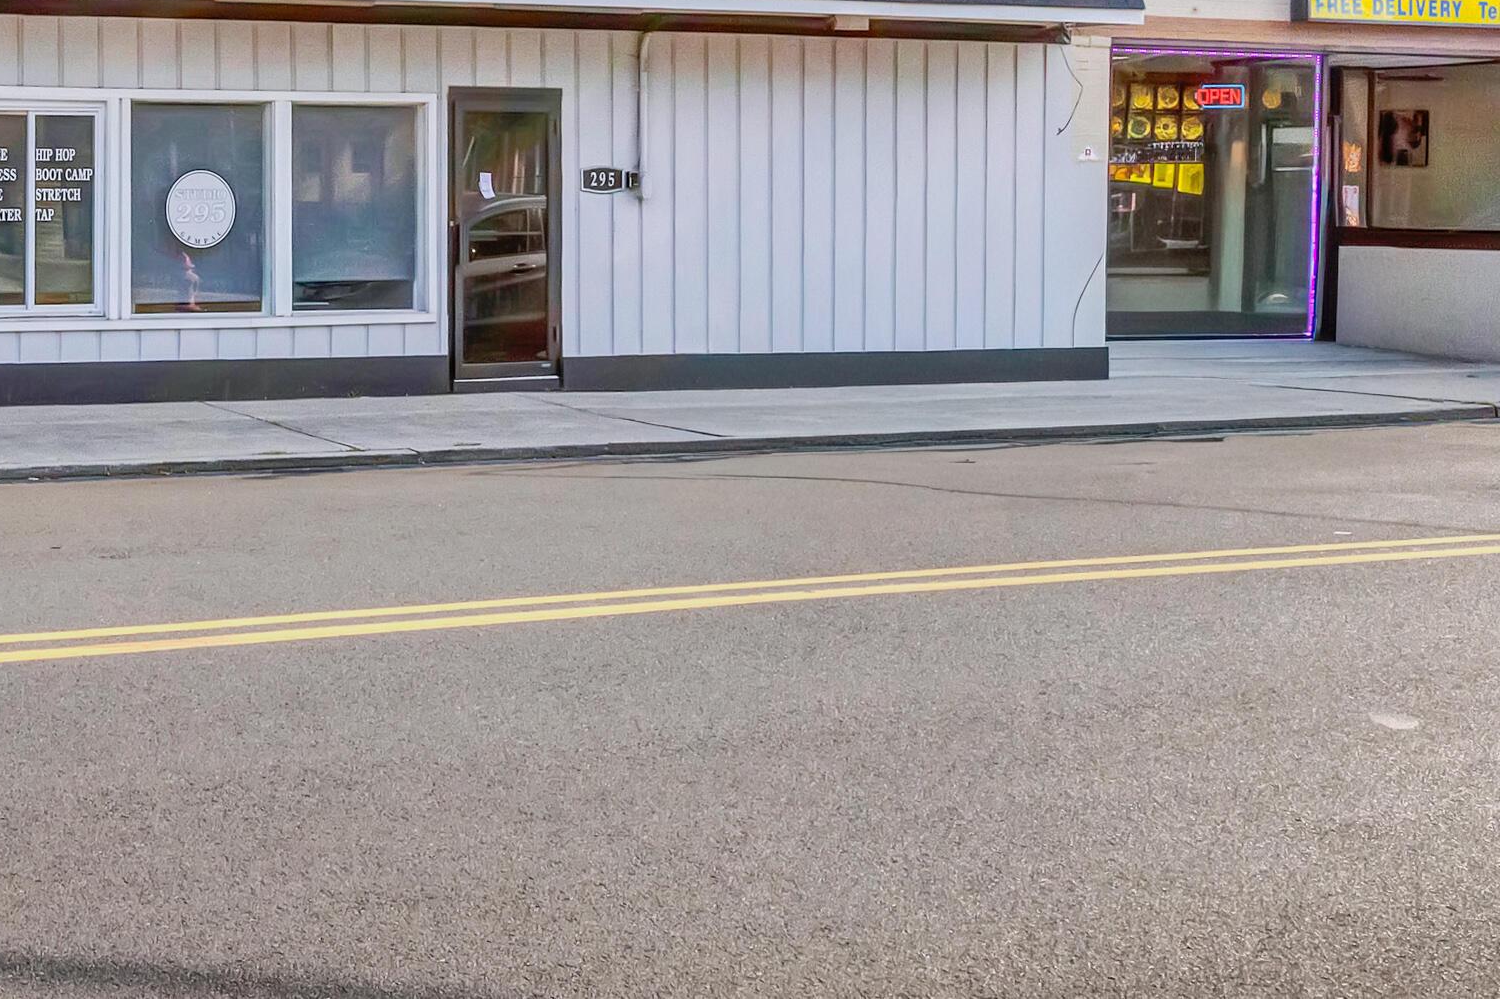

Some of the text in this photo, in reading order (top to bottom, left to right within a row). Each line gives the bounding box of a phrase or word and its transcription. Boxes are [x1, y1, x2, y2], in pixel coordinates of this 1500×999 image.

[1196, 88, 1241, 105] OPEN
[35, 148, 76, 161] HIP HOP
[35, 168, 93, 181] BOOT CAMP
[590, 171, 615, 187] 295
[35, 188, 81, 202] STRETCH
[174, 188, 228, 201] STUDIO
[35, 208, 55, 222] TAP
[175, 201, 227, 224] 295
